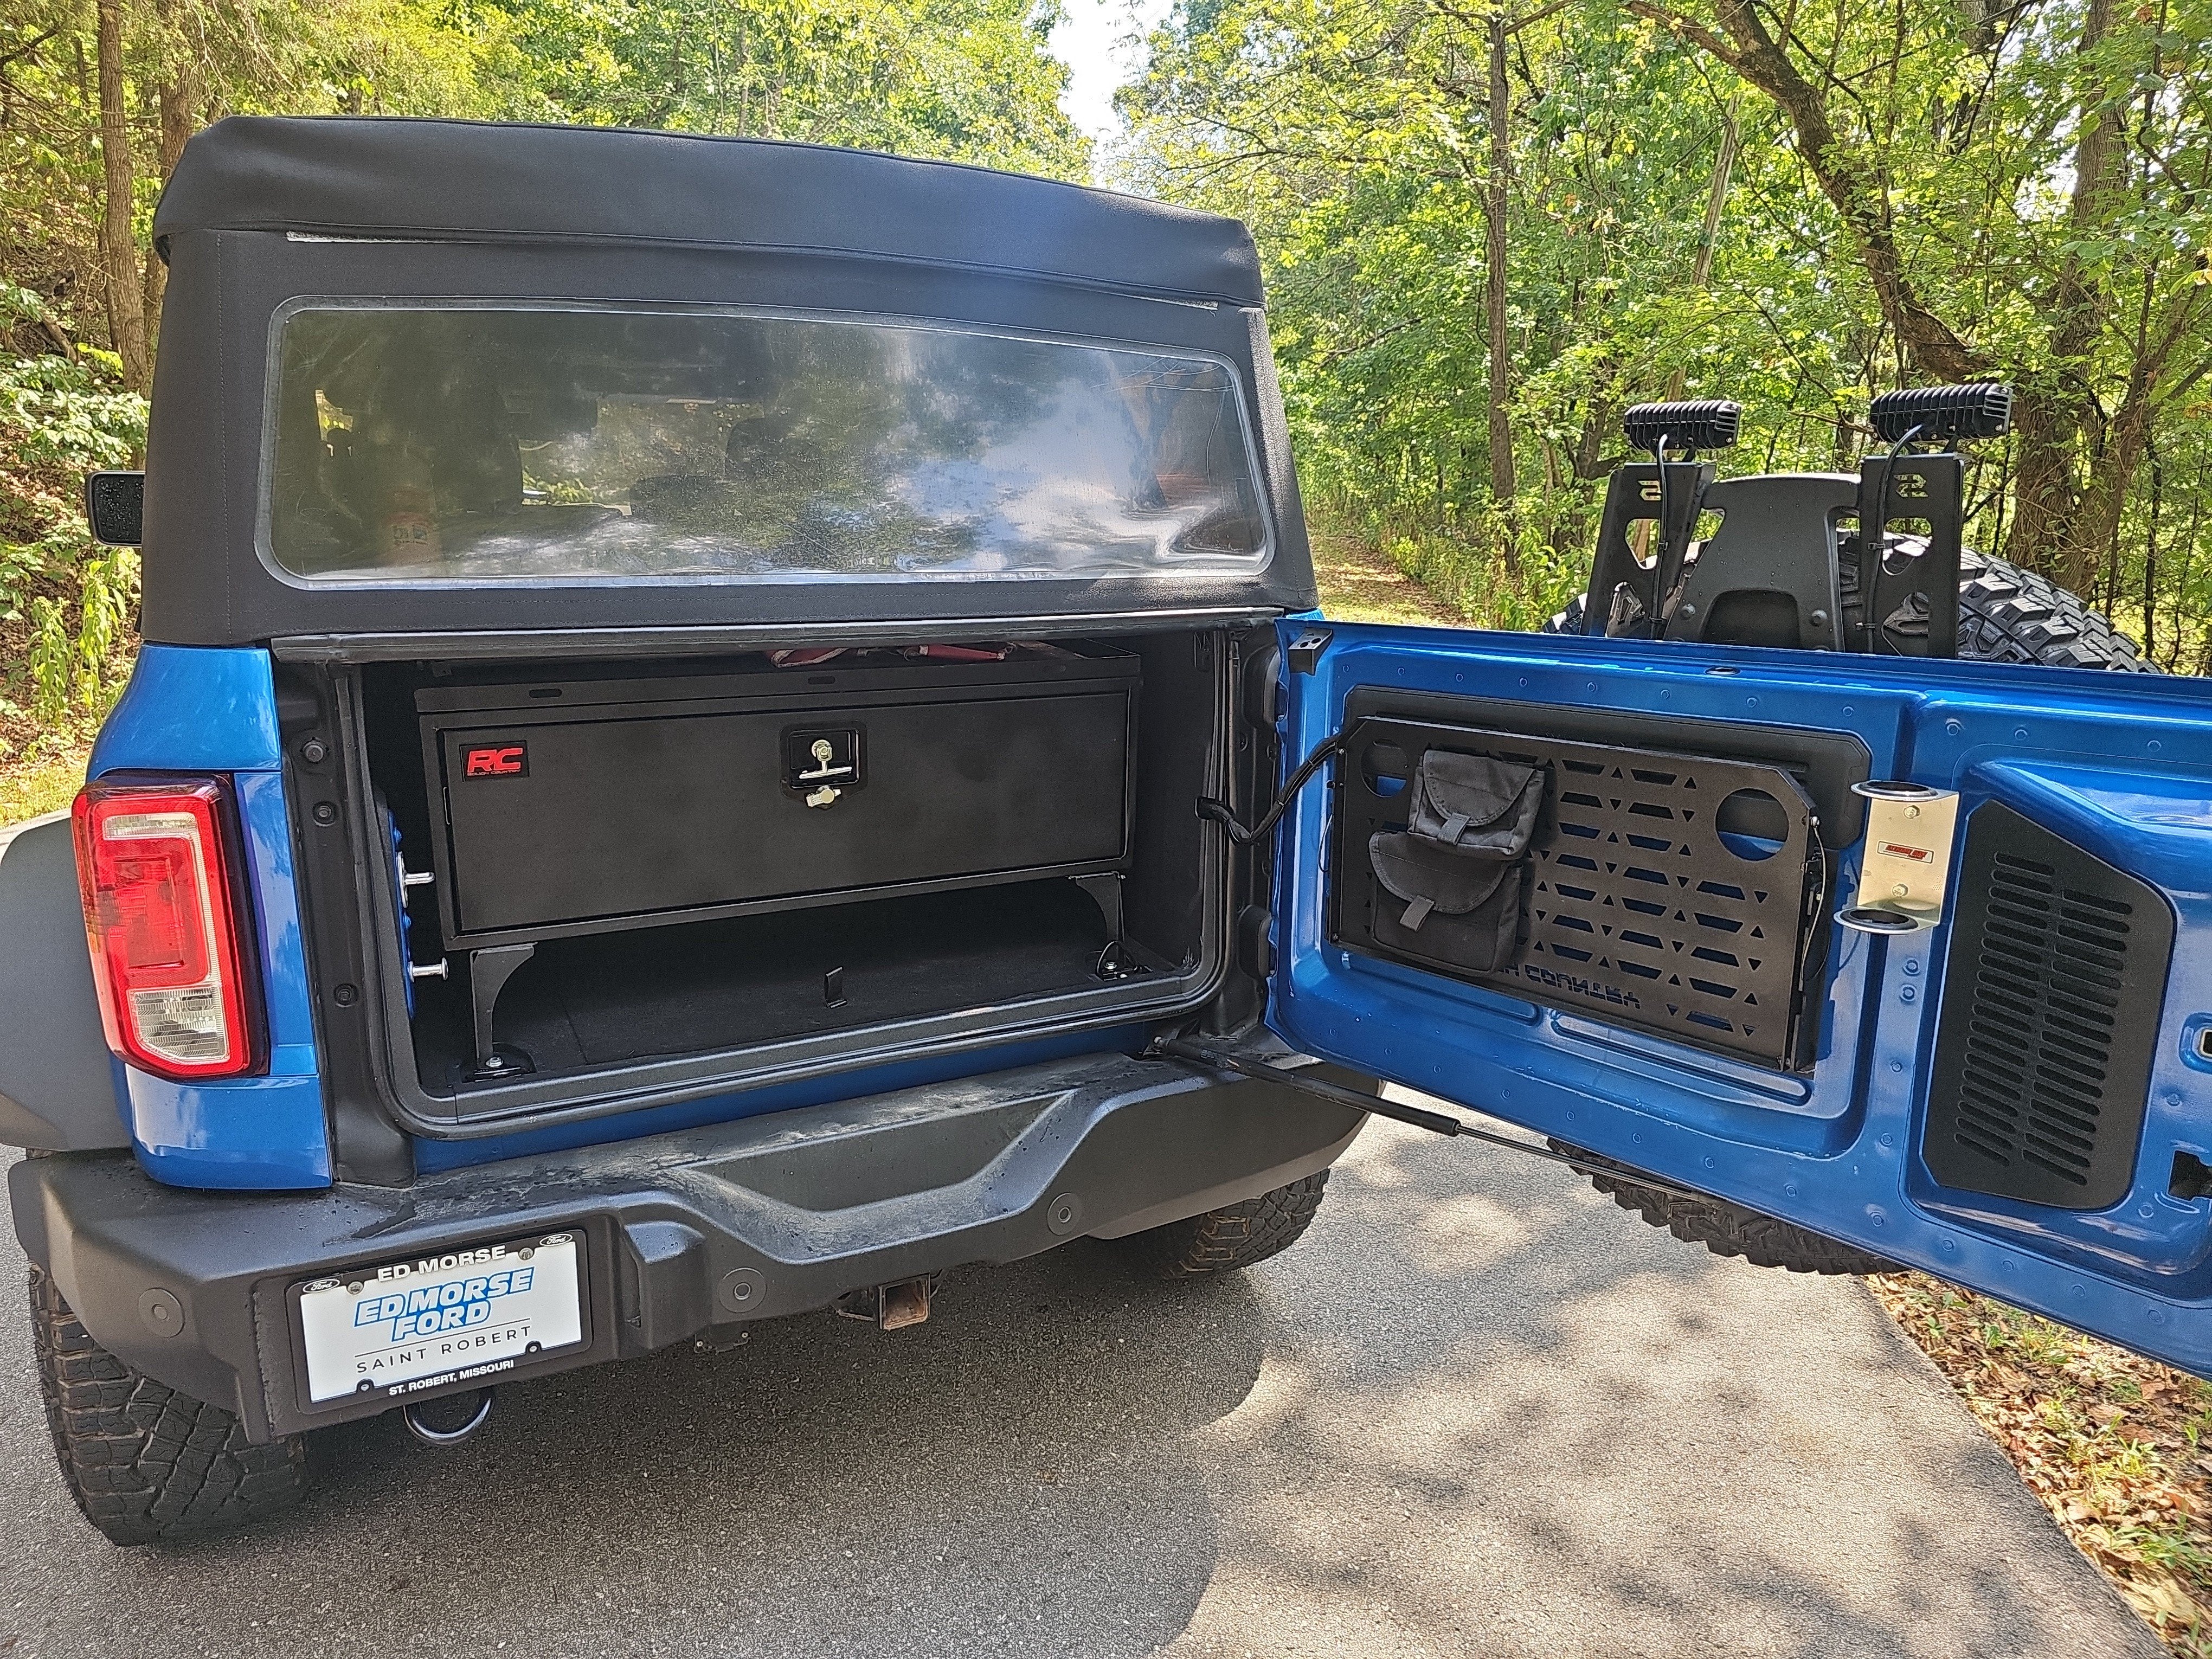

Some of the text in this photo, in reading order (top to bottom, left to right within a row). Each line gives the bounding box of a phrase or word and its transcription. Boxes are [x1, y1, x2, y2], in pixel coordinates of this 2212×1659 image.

[467, 748, 523, 773] RC
[546, 1234, 567, 1245] Ford
[377, 1245, 506, 1282] ED MORSE
[310, 1281, 332, 1291] Ford
[354, 1266, 535, 1327] ED MORSE
[391, 1299, 492, 1342] FORD
[356, 1326, 531, 1373] SAINT ROBERT
[388, 1359, 515, 1396] ST. ROBERT, MISSOURI
